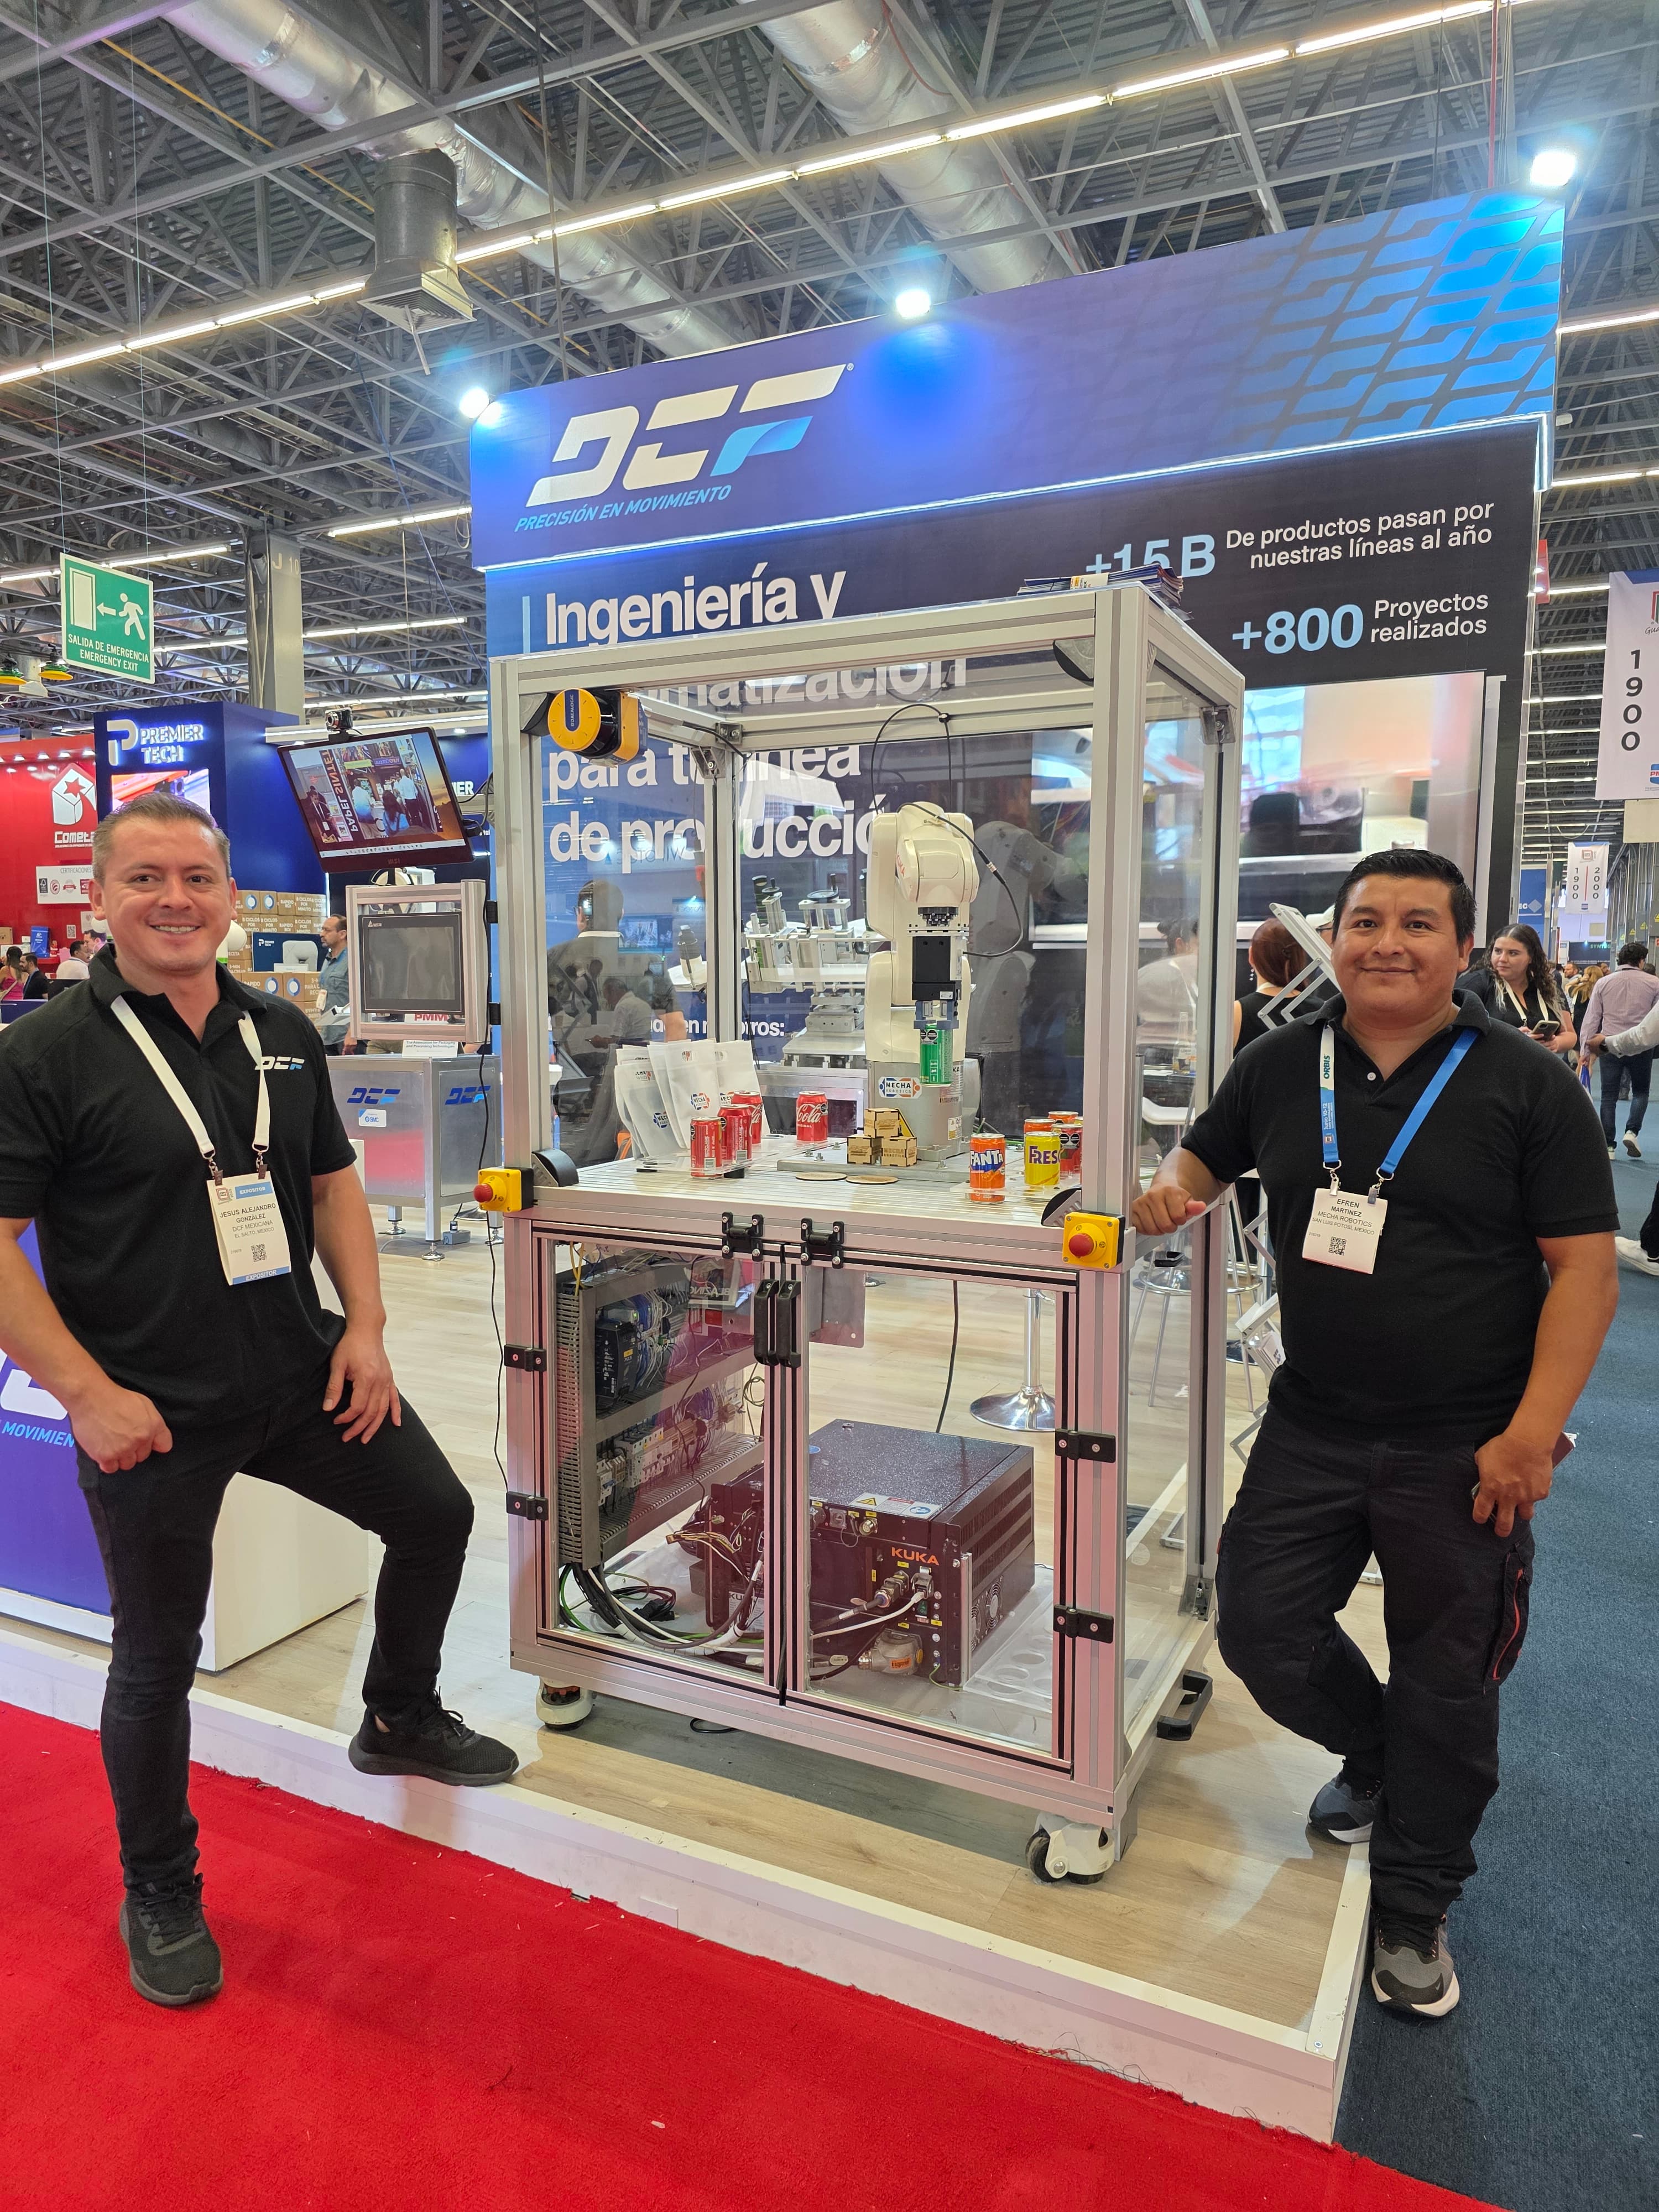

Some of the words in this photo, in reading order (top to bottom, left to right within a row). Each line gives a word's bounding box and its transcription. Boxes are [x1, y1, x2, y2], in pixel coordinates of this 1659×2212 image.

[514, 503, 599, 533] PRECISIÓN
[599, 503, 623, 520] EN
[624, 484, 732, 515] MOVIMIENTO
[1226, 529, 1255, 549] De
[1261, 515, 1371, 548] productos
[1378, 507, 1447, 536] pasan
[1454, 500, 1495, 527] por
[1250, 544, 1343, 570] nuestras
[1349, 534, 1414, 560] líneas
[1421, 529, 1441, 550] al
[1448, 525, 1493, 548] año
[546, 562, 799, 647] Ingeniería
[810, 571, 847, 620] y
[1374, 591, 1489, 620] Proyectos
[1232, 604, 1364, 655] +800
[1371, 615, 1488, 643] realizados
[68, 634, 93, 649] SALIDA
[95, 640, 105, 651] DE
[106, 644, 149, 663] EMERGENCIA
[80, 649, 121, 667] EMERGENCY
[123, 660, 138, 672] EXIT
[140, 723, 204, 744] PREMIER
[140, 745, 184, 764] TECH
[550, 811, 610, 863] de
[414, 1013, 449, 1021] PMM
[970, 1150, 1004, 1166] FANTA
[239, 1186, 266, 1195] EXPOSITOR
[220, 1209, 240, 1218] JESUS
[241, 1203, 276, 1214] ALEJANDRO
[1331, 1206, 1363, 1217] MARTINEZ
[1337, 1198, 1360, 1208] EFREN
[236, 1213, 266, 1223] GONZÁLEZ
[245, 1220, 274, 1230] MEXICANA
[1318, 1211, 1338, 1220] MECHA
[1339, 1215, 1373, 1228] ROBOTICS
[1354, 1227, 1375, 1235] MEXICO
[246, 1269, 277, 1281] EXPOSITOR
[1, 1421, 75, 1448] MOVIMIEN
[891, 1546, 940, 1566] KUKA
